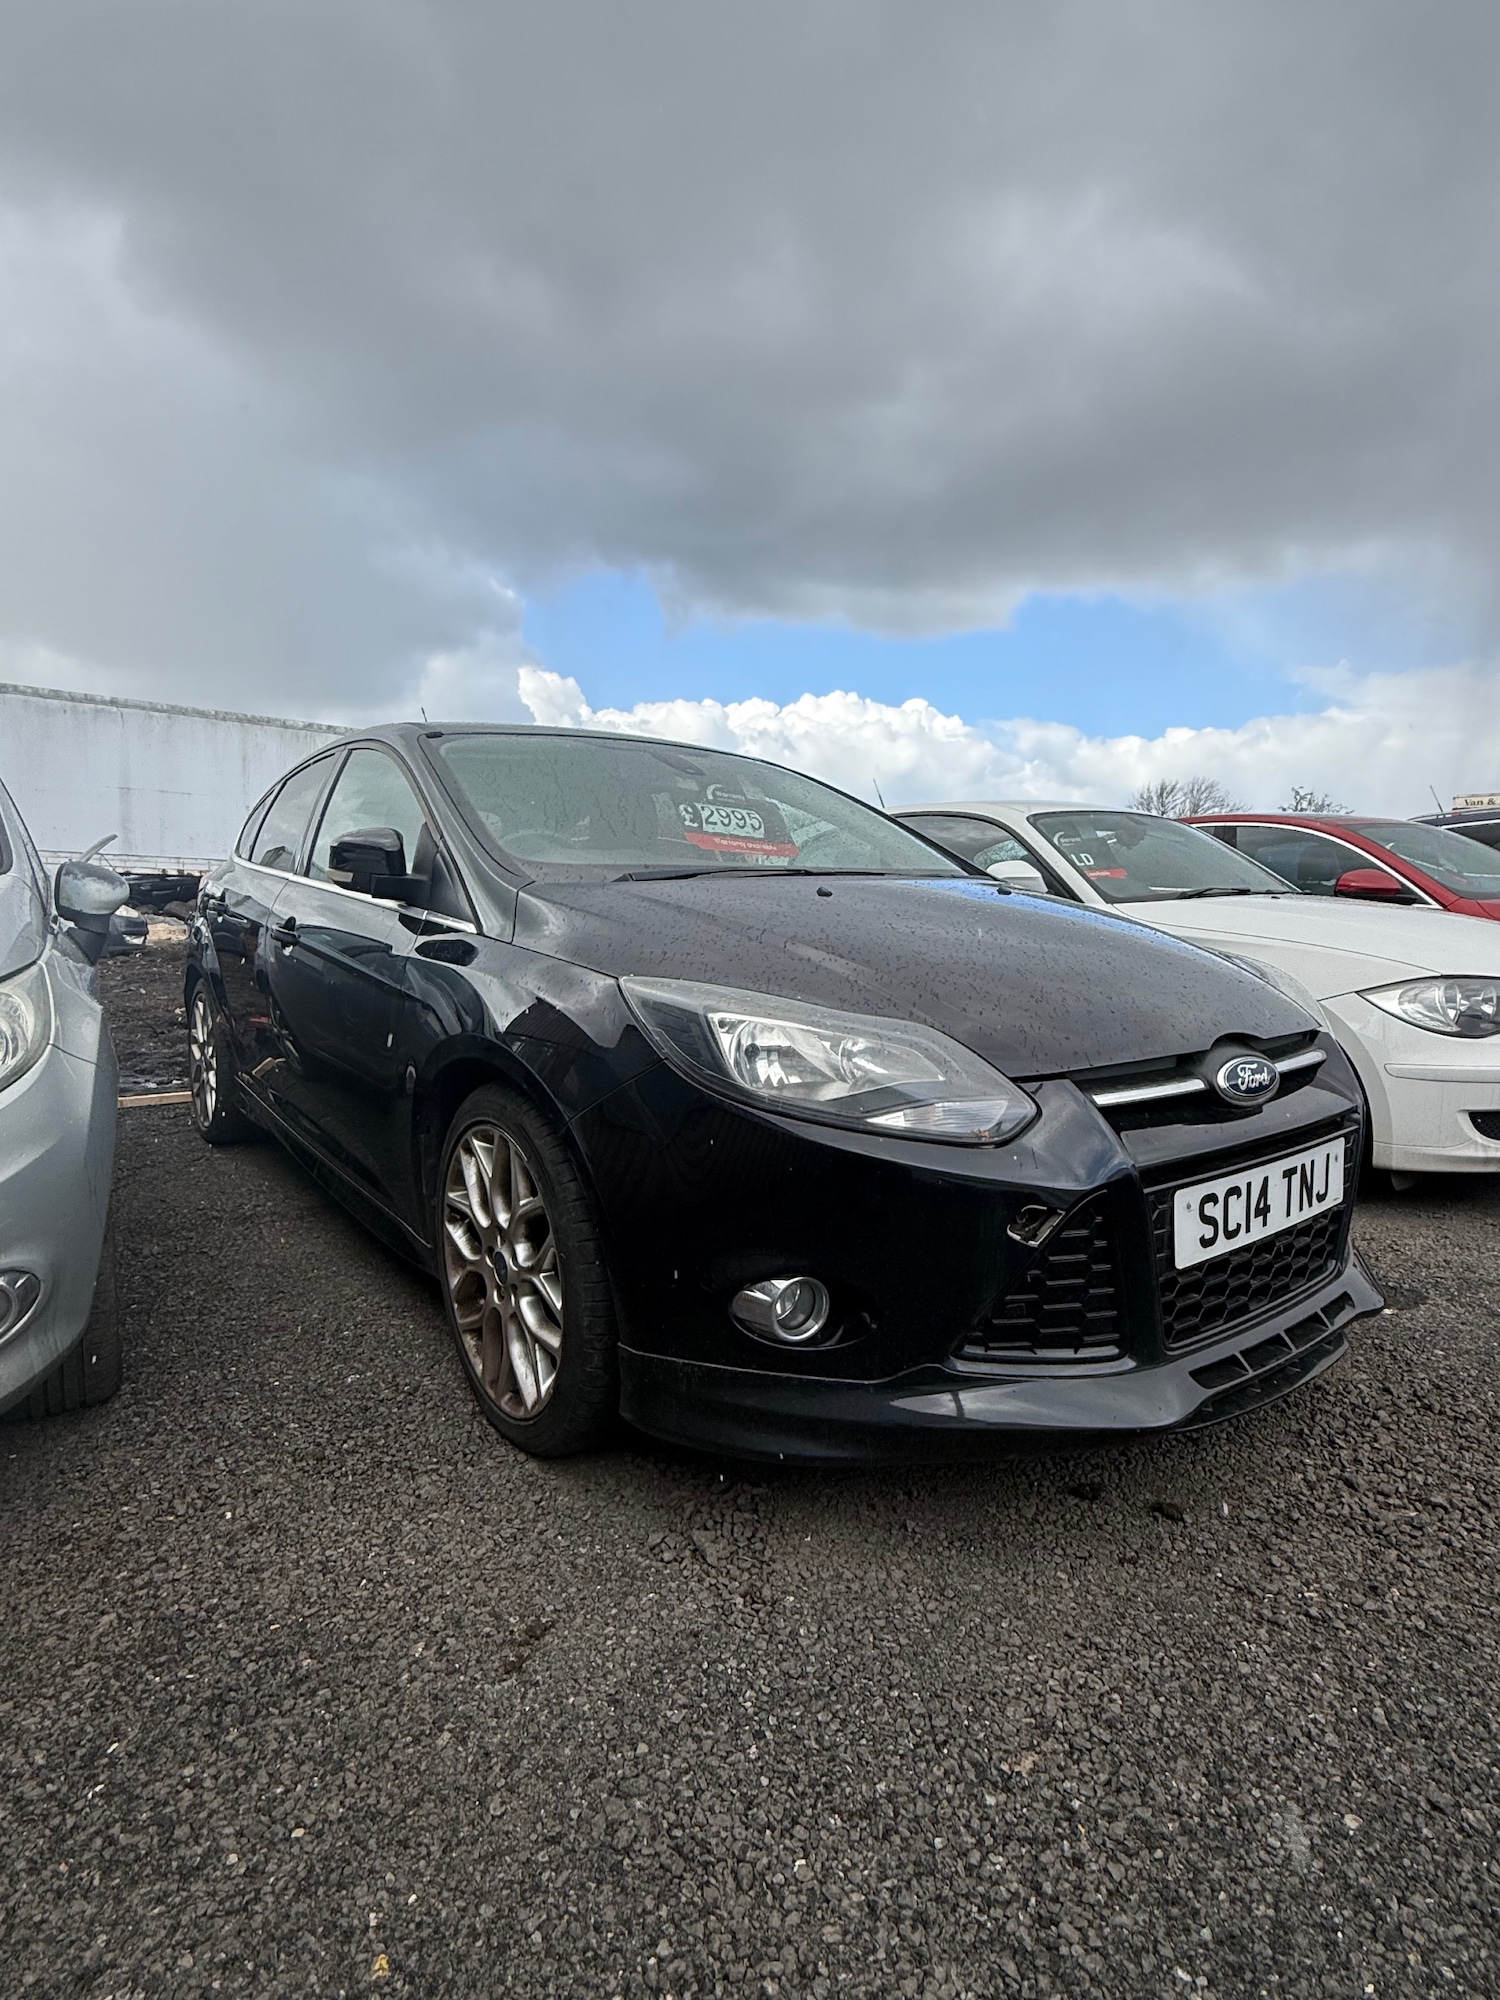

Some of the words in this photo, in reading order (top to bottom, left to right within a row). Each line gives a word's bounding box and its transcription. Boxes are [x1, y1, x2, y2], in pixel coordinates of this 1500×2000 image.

[1487, 798, 1497, 806] &
[1237, 1063, 1271, 1091] Ford
[1199, 1175, 1271, 1249] SC14
[1282, 1153, 1330, 1218] TNJ
